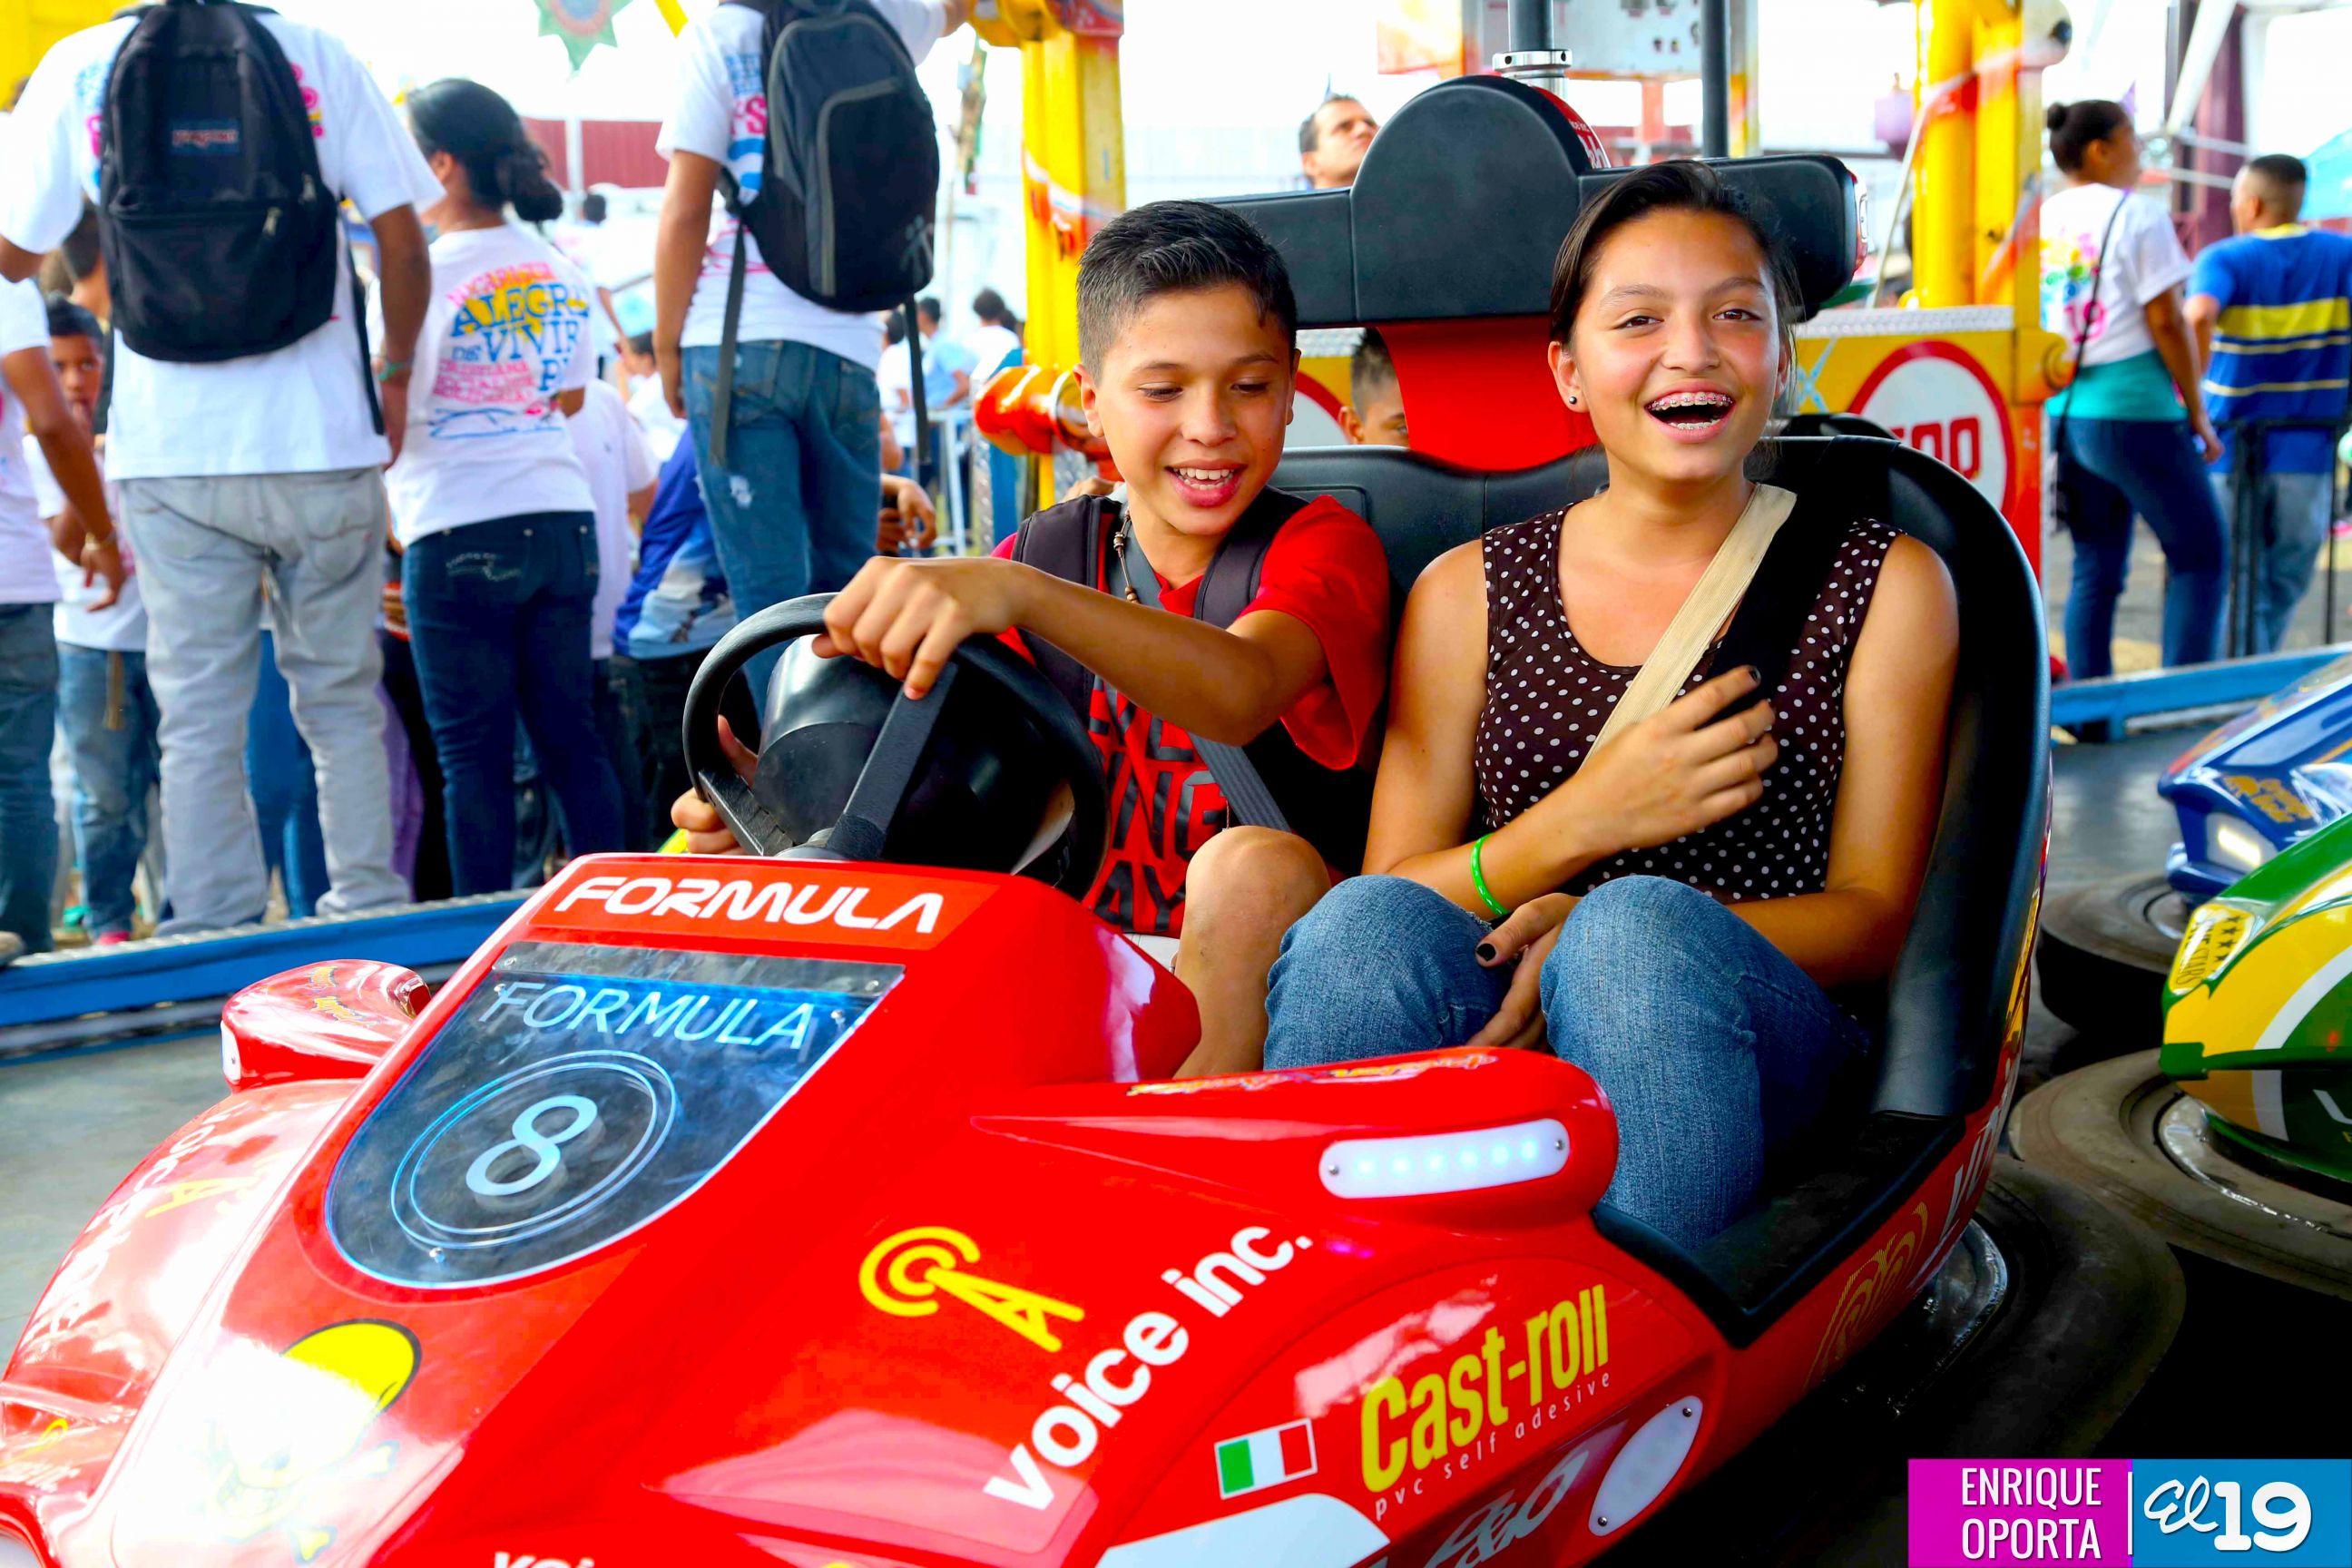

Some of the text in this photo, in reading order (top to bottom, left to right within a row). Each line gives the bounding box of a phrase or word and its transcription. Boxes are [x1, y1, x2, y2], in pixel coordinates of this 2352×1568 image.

[554, 876, 944, 934] FORMULA
[479, 982, 812, 1050] FORMULA
[466, 1094, 598, 1197] 8
[983, 1311, 1189, 1510] voice
[1161, 1226, 1313, 1318] inc.
[1361, 1284, 1608, 1493] Cast-roll
[1376, 1372, 1611, 1522] pvc self adesive
